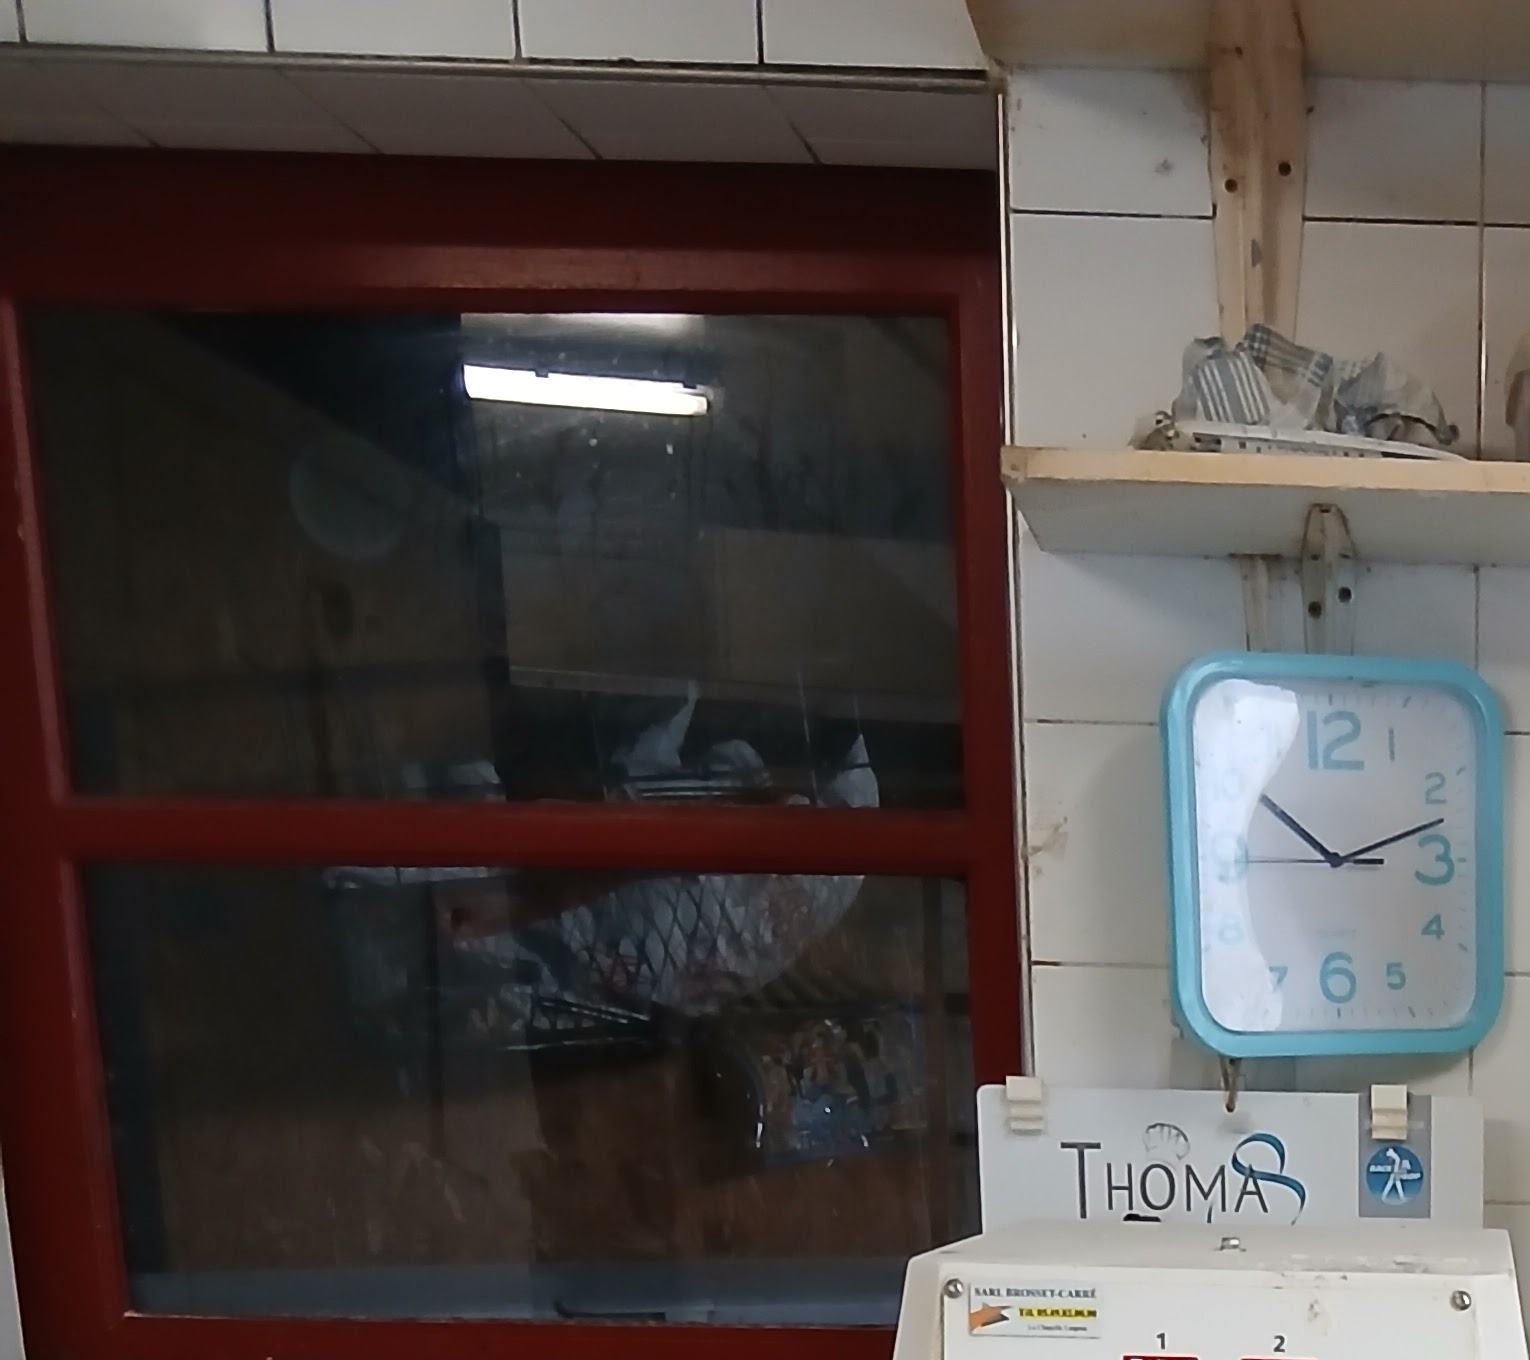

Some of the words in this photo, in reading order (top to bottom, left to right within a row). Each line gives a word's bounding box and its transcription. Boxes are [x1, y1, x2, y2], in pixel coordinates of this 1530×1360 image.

[1307, 710, 1365, 771] 12
[1388, 727, 1396, 761] 1
[1424, 771, 1447, 805] 2
[1414, 834, 1456, 886] 3
[1420, 914, 1445, 940] 4
[1268, 965, 1289, 993] 7
[1319, 951, 1358, 1004] 6
[1385, 961, 1407, 991] 5
[1156, 1332, 1167, 1350] 1
[1273, 1335, 1286, 1353] 2
